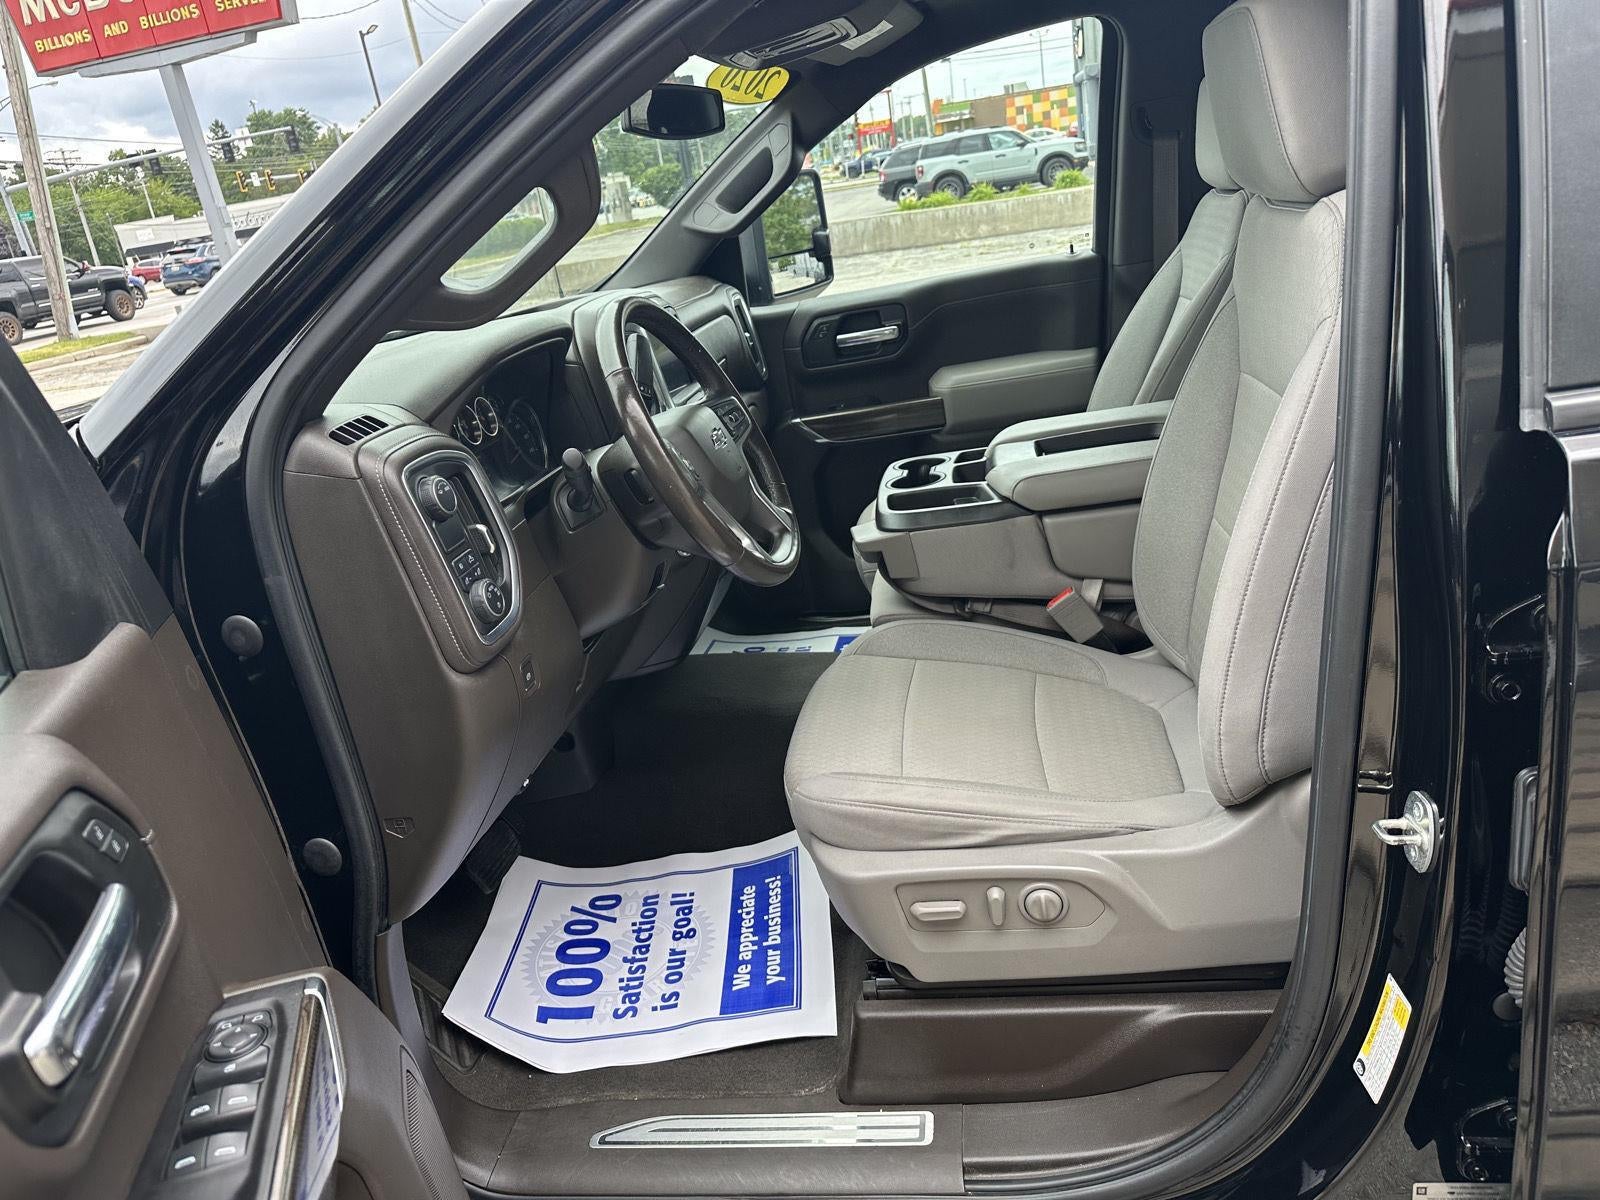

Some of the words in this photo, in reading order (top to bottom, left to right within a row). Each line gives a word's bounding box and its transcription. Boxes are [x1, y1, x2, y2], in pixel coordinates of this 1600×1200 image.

[35, 29, 91, 53] BILLIONS
[104, 20, 129, 37] AND
[139, 3, 200, 29] BILLIONS
[670, 891, 697, 939] goal!
[733, 885, 757, 957] appreciate
[763, 875, 782, 945] business!
[536, 893, 622, 1024] 100%
[612, 893, 660, 1019] Satisfaction
[664, 948, 687, 985] our
[731, 966, 750, 992] We
[765, 950, 786, 987] your
[651, 991, 680, 1012] is
